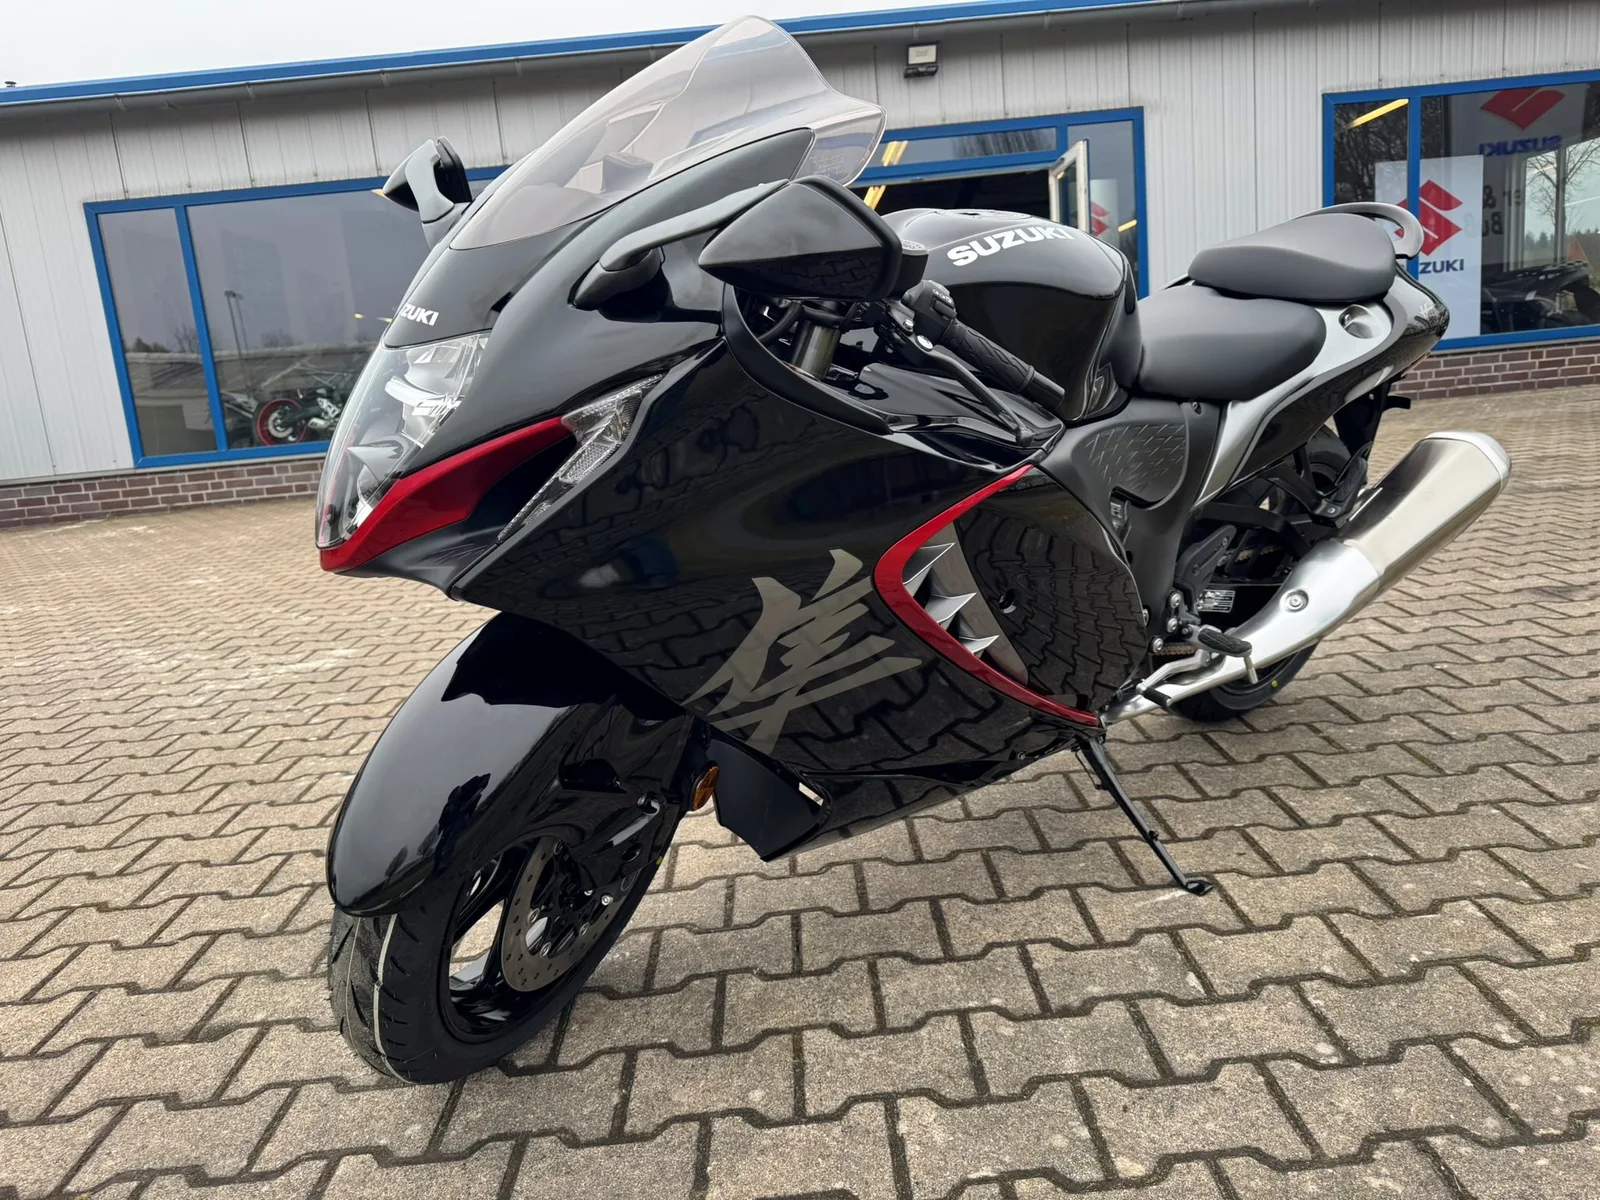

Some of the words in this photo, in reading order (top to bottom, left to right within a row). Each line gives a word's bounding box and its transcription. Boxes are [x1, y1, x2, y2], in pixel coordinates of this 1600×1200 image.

[947, 224, 1075, 267] SUZUKI
[1418, 258, 1465, 275] ZUKI
[400, 302, 439, 326] ZUKI
